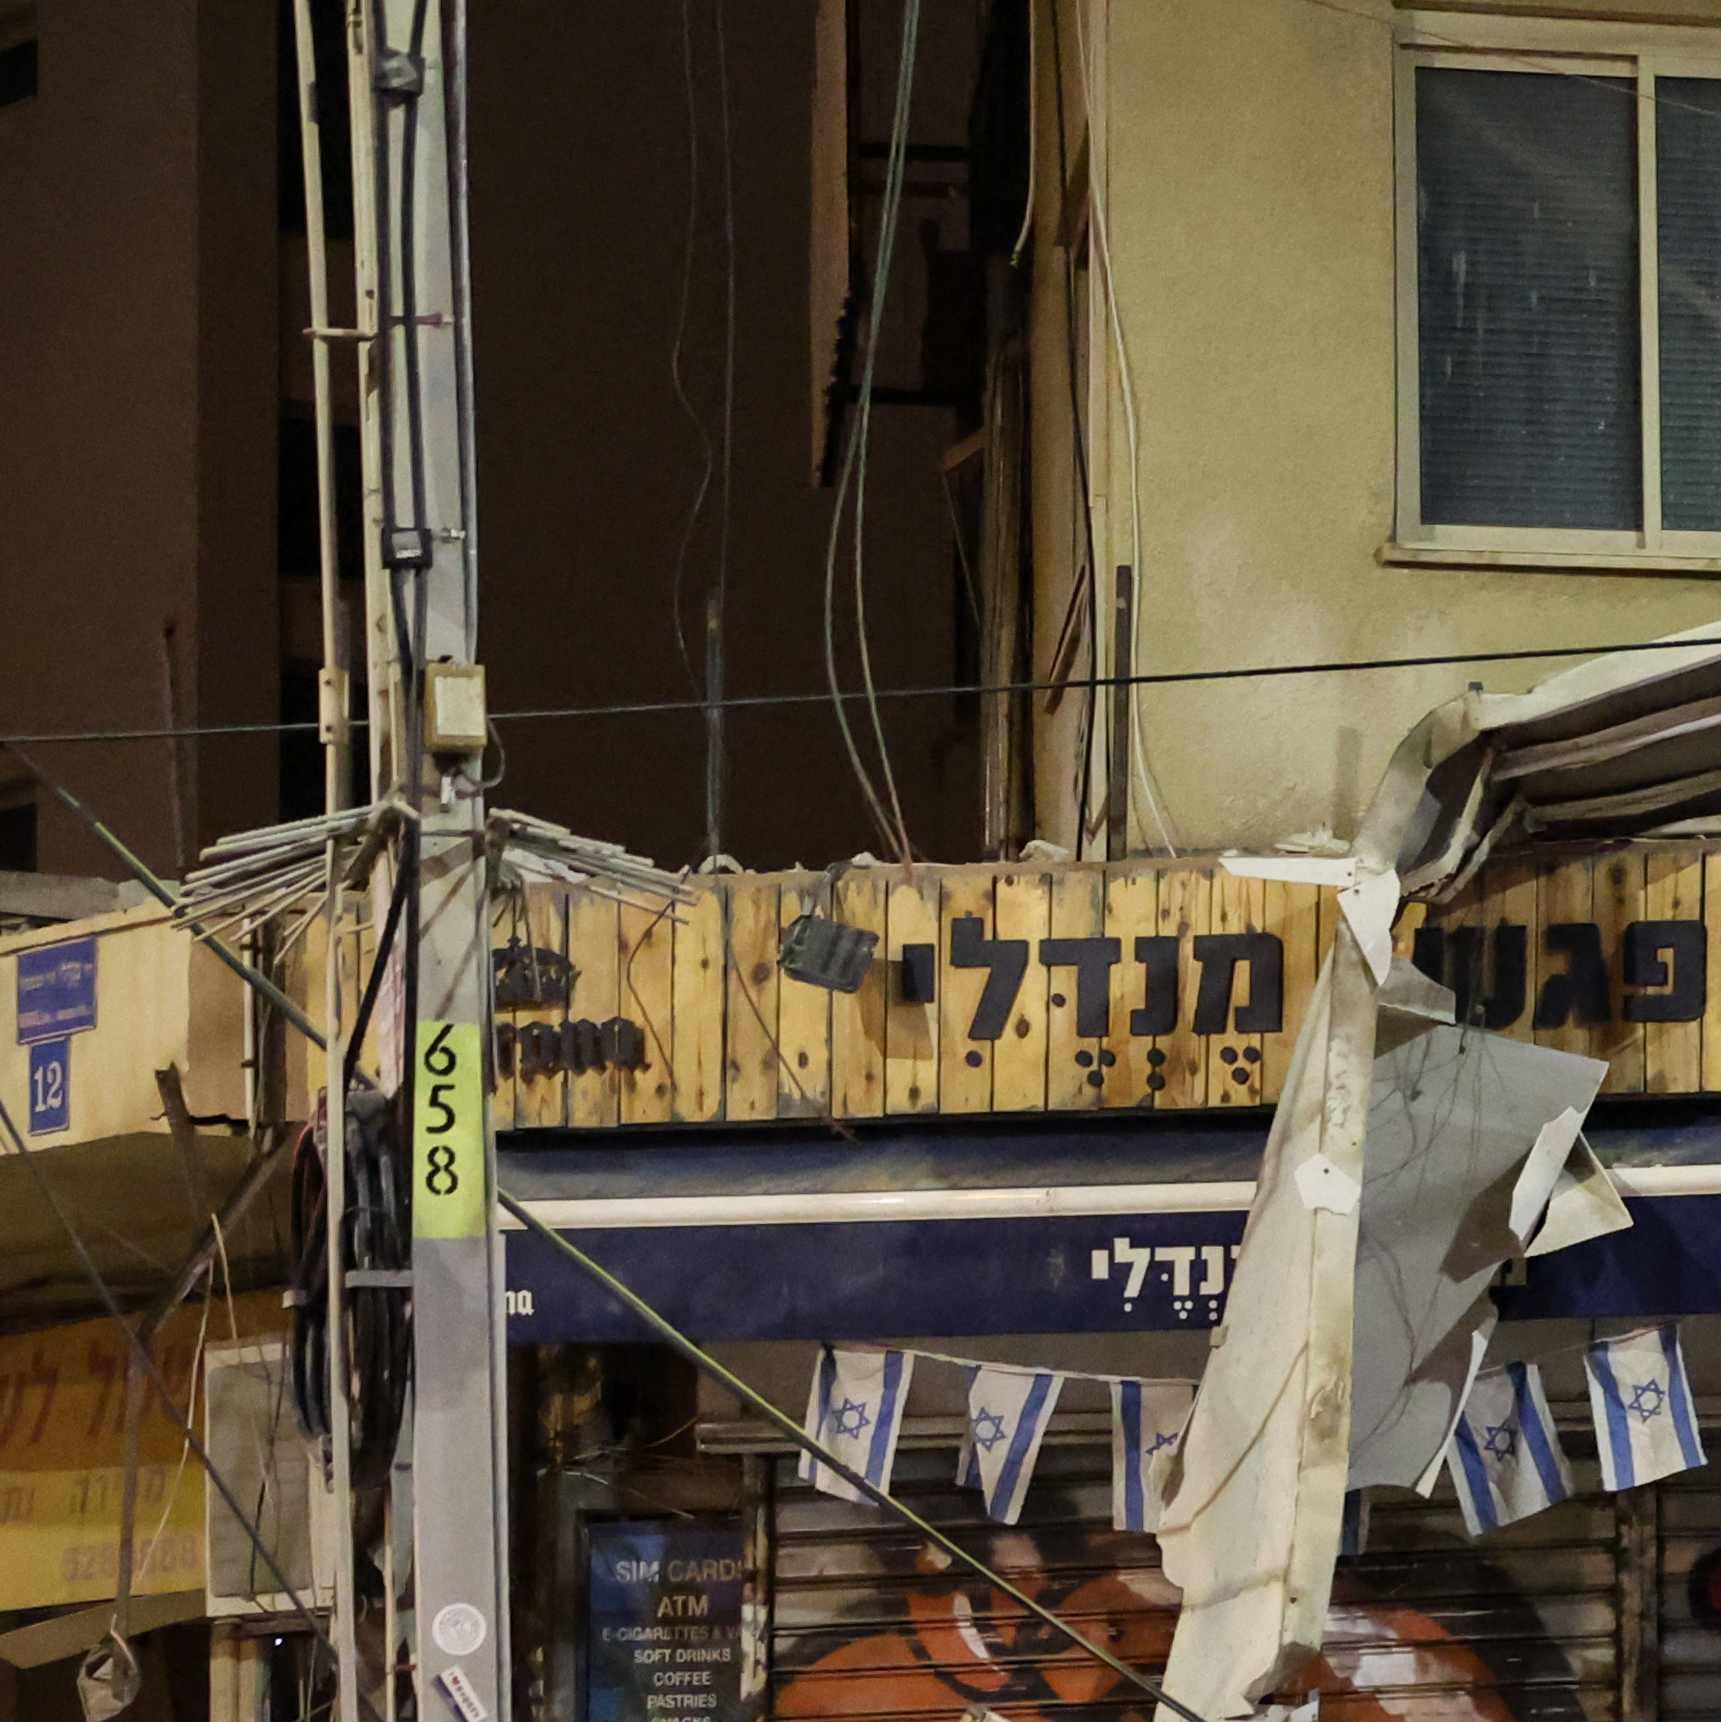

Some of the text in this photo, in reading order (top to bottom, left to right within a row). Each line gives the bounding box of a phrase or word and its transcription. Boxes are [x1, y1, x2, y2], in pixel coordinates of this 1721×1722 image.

[34, 1060, 64, 1113] 12
[424, 1023, 459, 1196] 658
[1091, 1236, 1241, 1321] נדלי
[615, 1560, 661, 1584] SIM
[656, 1594, 709, 1618] ATM
[634, 1647, 731, 1664] SOFT DRINKS
[653, 1670, 712, 1686] COFFEE
[647, 1693, 718, 1709] PASTRIES
